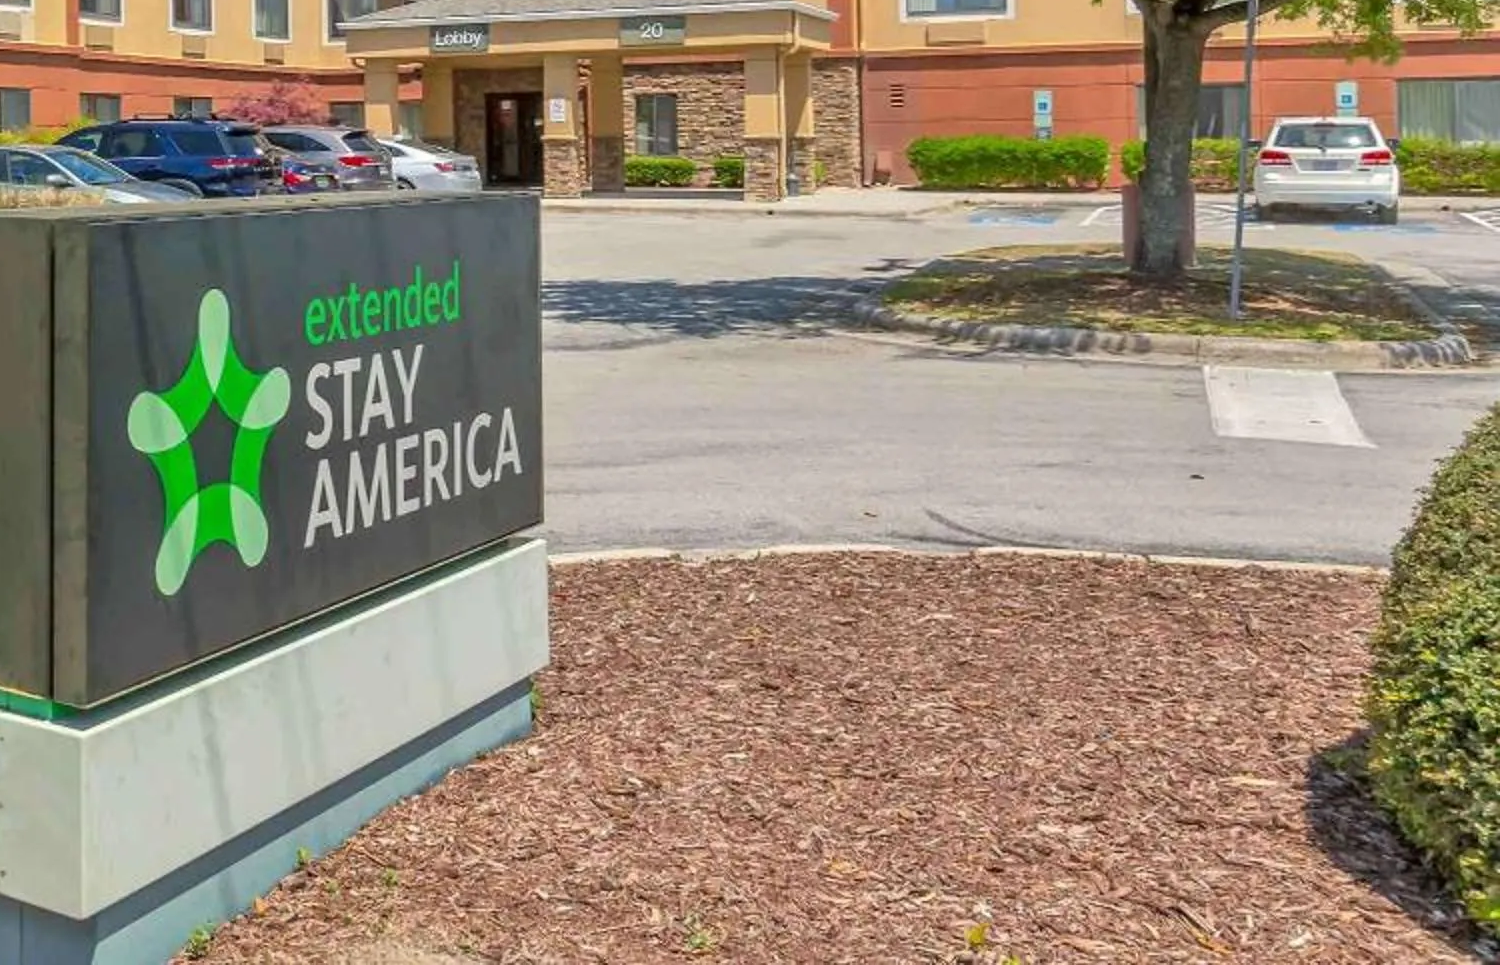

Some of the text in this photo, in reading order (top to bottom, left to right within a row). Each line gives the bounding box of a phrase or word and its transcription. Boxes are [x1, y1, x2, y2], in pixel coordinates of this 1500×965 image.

[435, 30, 483, 47] Lobby
[639, 23, 663, 39] 20
[304, 260, 461, 346] extended
[304, 344, 424, 450] STAY
[303, 407, 524, 549] AMERICA
